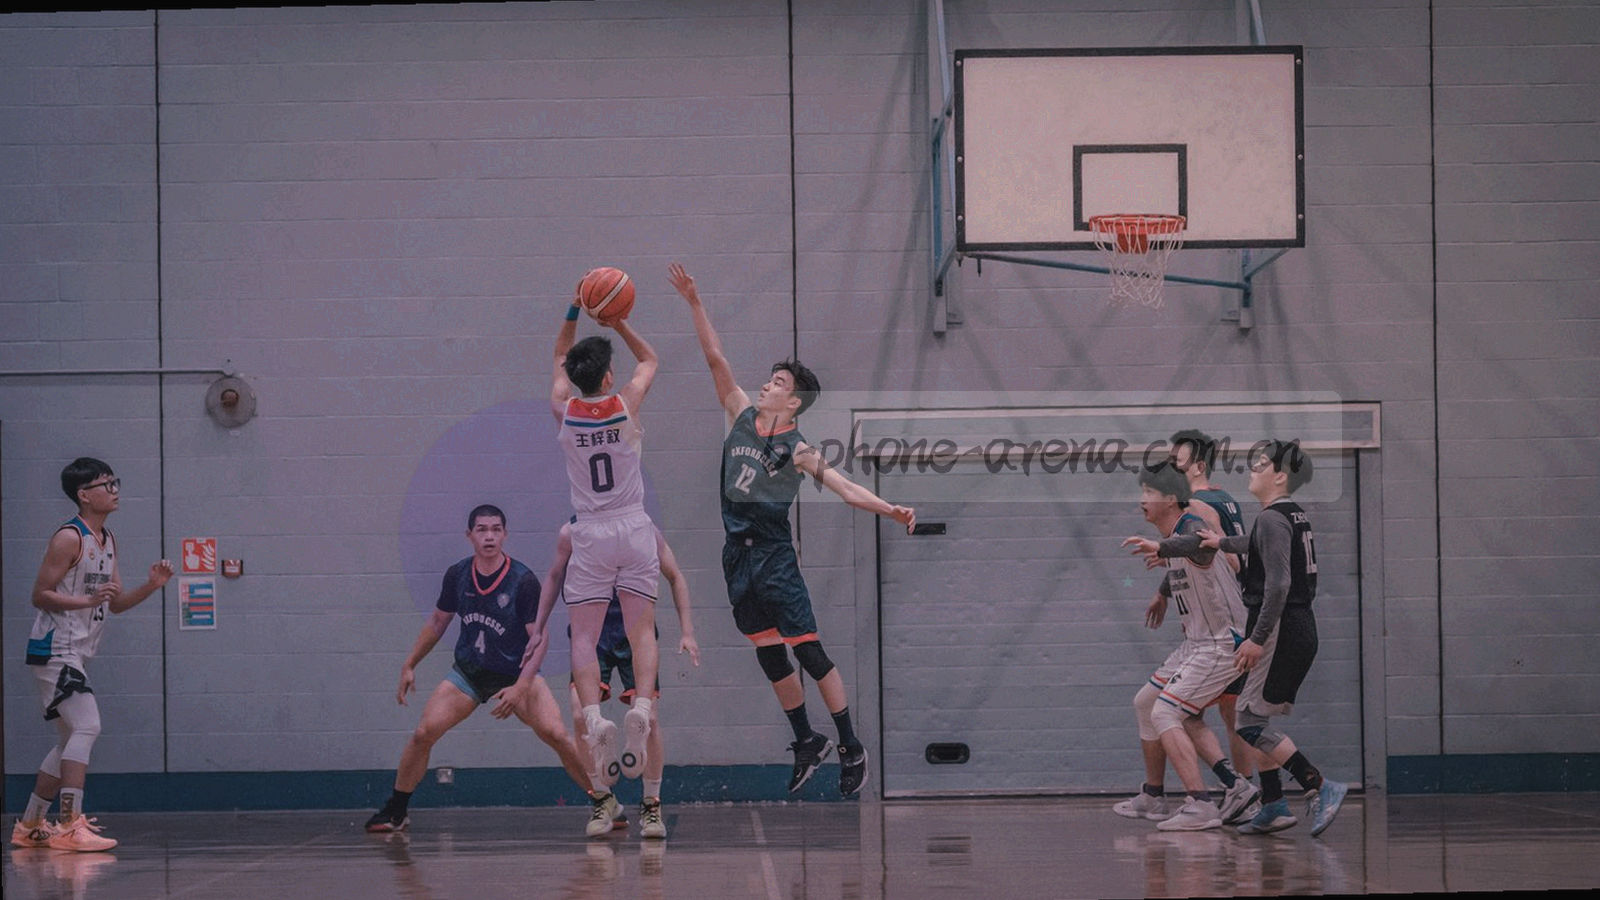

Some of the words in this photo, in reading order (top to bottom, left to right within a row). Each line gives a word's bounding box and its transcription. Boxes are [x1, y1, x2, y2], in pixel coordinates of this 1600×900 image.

[588, 452, 615, 493] 0
[734, 462, 757, 494] 12
[474, 629, 486, 654] 4
